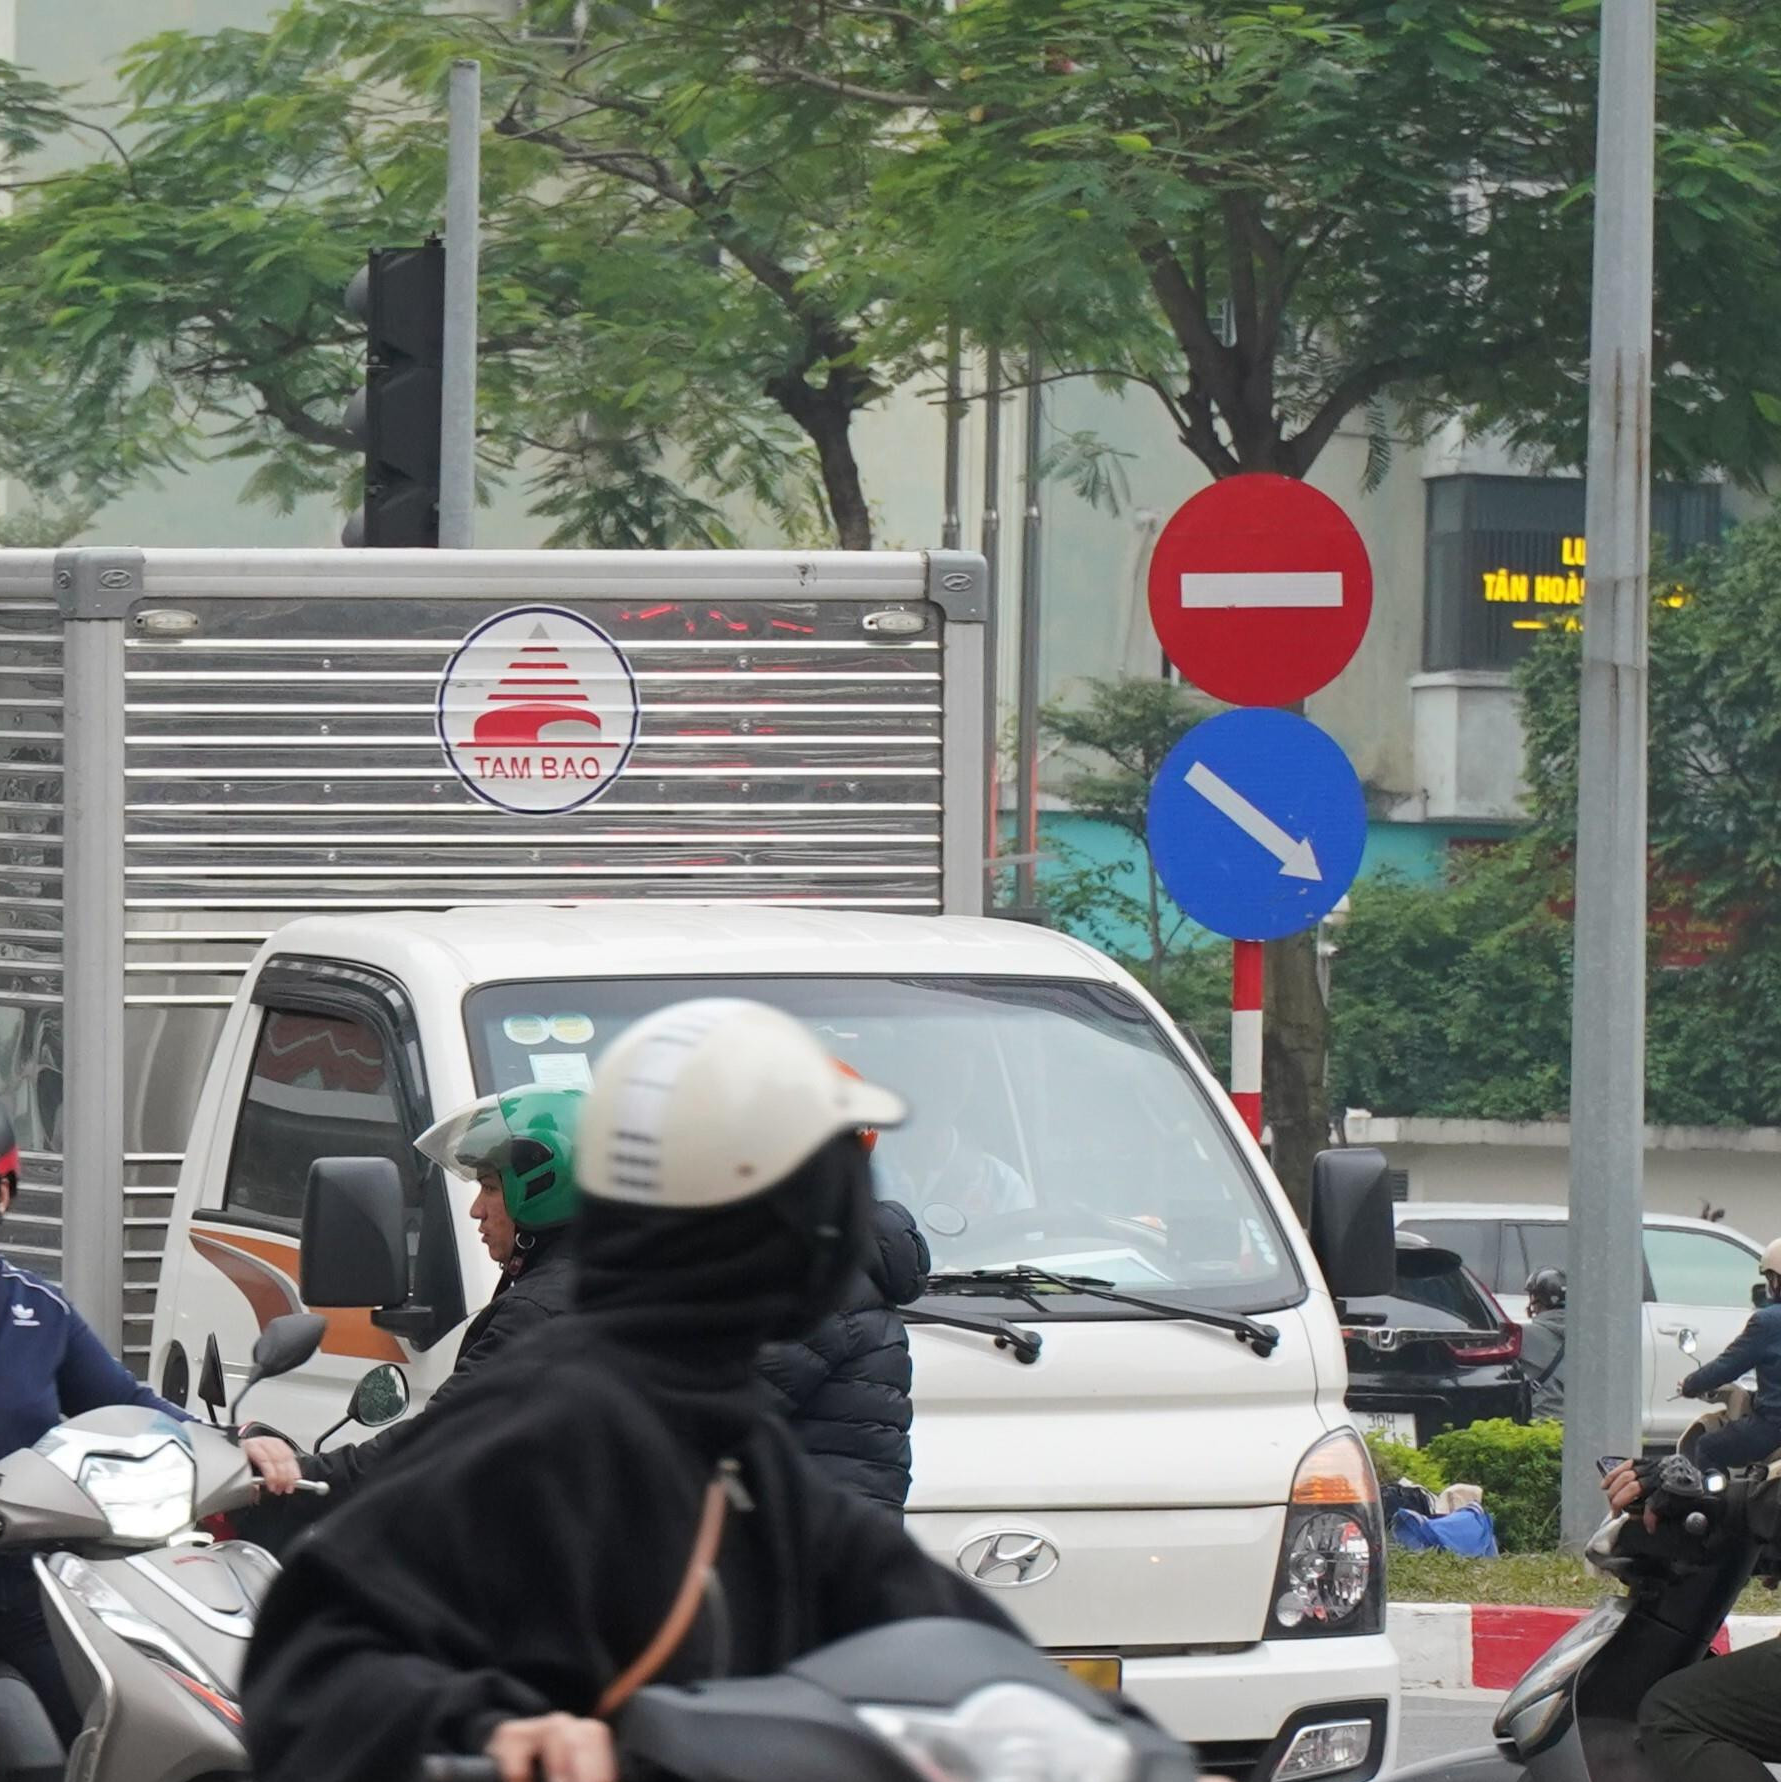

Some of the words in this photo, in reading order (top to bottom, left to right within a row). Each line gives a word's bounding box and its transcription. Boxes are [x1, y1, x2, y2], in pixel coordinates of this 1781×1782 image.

[1483, 568, 1528, 602] TÂN
[1535, 571, 1585, 604] HOÀ
[474, 757, 530, 779] TAM
[542, 757, 600, 779] BAO
